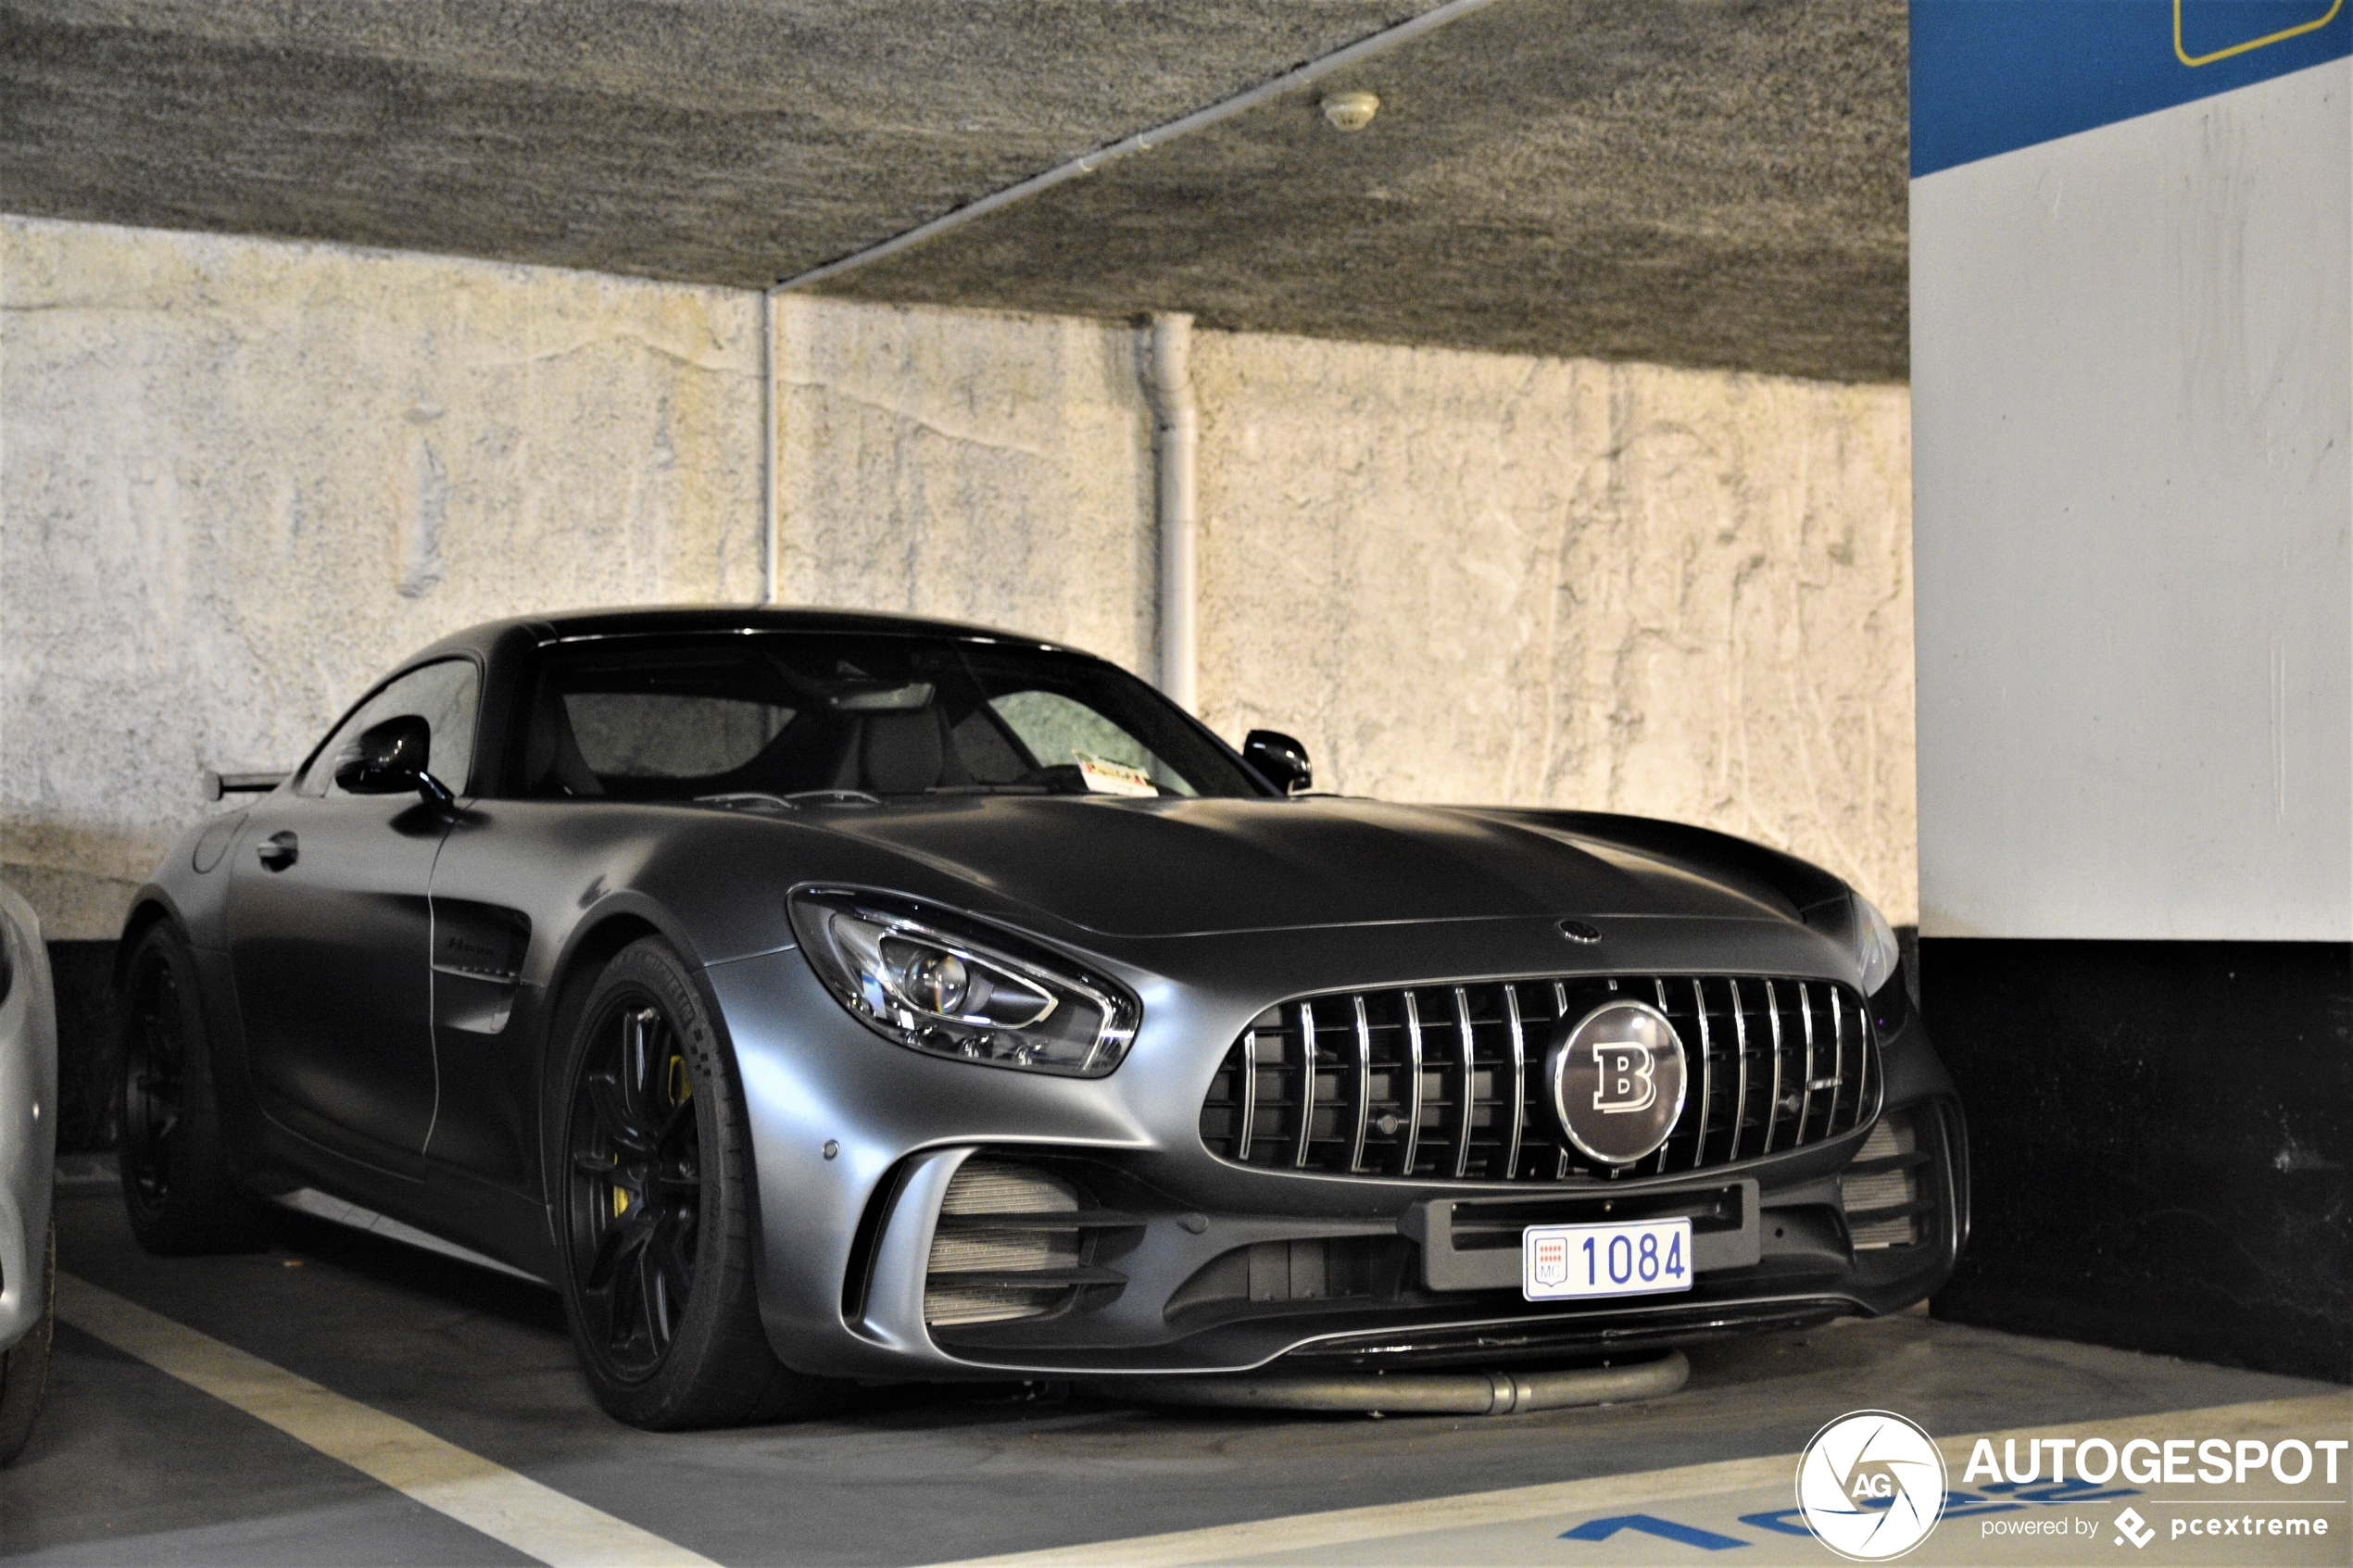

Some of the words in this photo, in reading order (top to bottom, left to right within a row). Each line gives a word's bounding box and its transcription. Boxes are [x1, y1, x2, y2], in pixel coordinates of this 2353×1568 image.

[1592, 1041, 1657, 1114] B
[1540, 1264, 1561, 1279] MC
[1583, 1231, 1686, 1286] 1084
